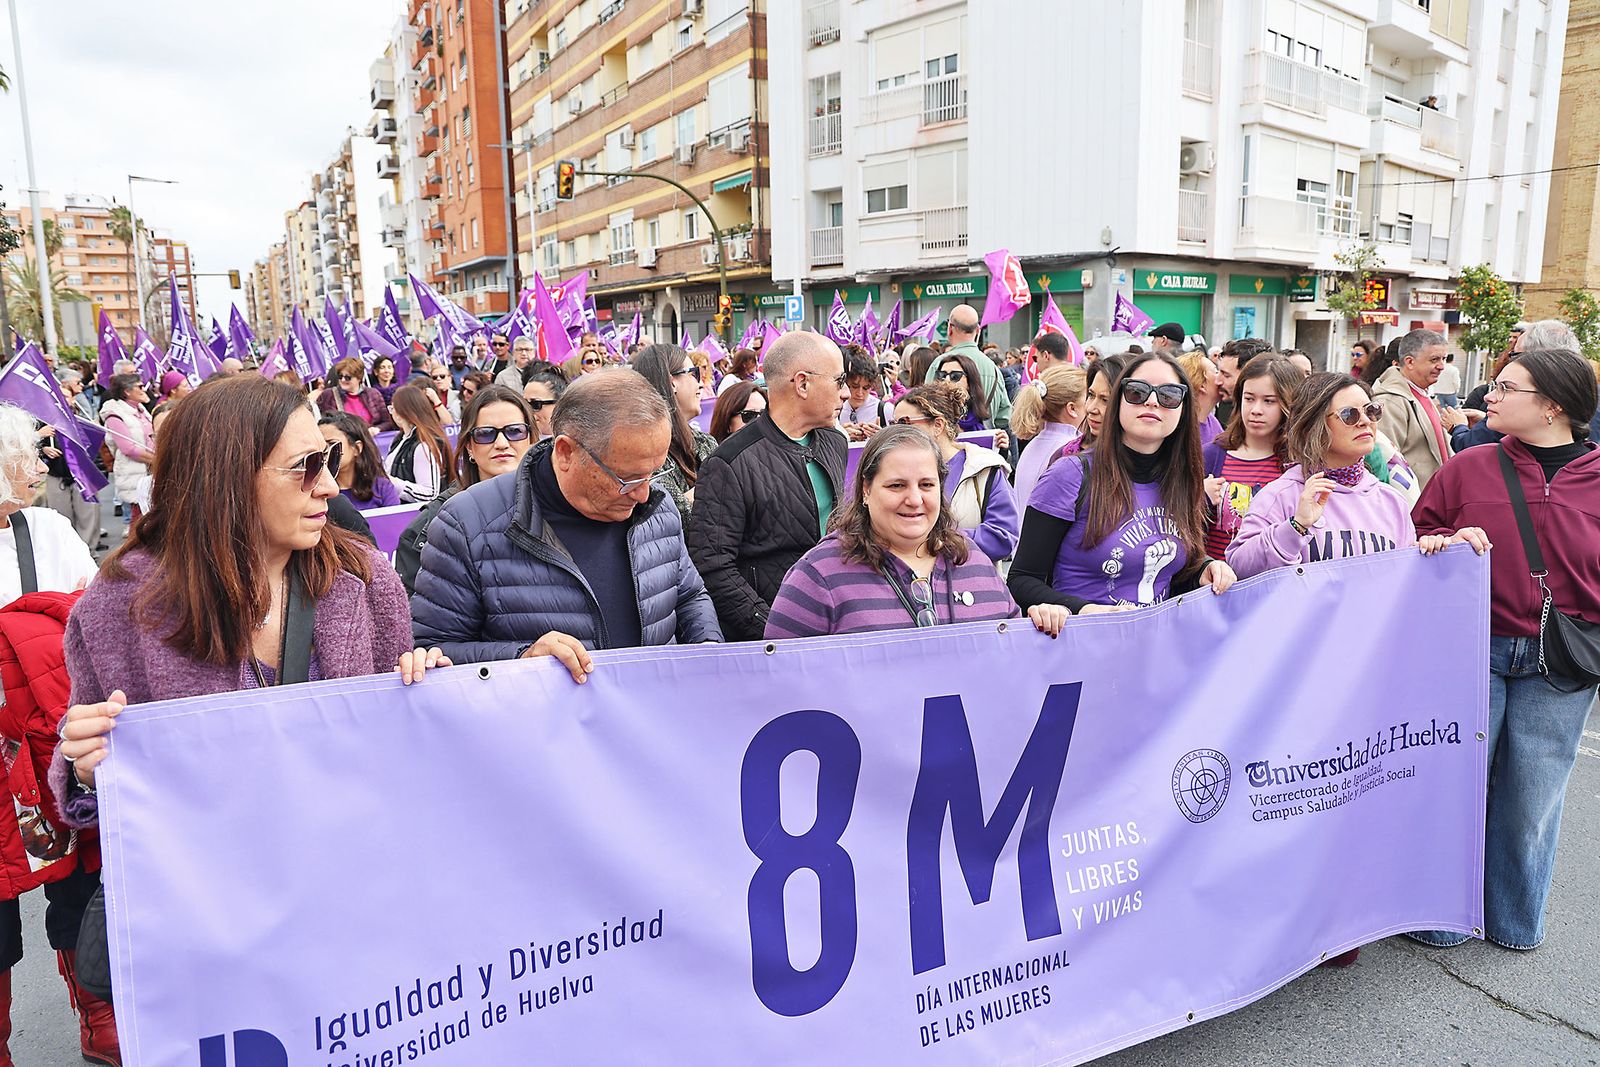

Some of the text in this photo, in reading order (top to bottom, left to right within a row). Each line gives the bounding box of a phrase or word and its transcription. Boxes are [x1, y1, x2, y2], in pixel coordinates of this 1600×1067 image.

[926, 282, 974, 296] CAJA RURAL
[1161, 274, 1208, 289] CAJA RURAL
[788, 299, 799, 319] P
[1119, 517, 1183, 549] VIVAS. LIBR
[1245, 719, 1461, 788] Universidad de Huelva
[1249, 782, 1339, 808] Vicerrectorado
[1341, 777, 1352, 791] de
[1252, 804, 1304, 823] Campus
[1307, 790, 1353, 813] Saludable
[1359, 775, 1385, 799] Justicia
[1386, 765, 1416, 783] Social
[1061, 821, 1148, 858] JUNTAS,
[1066, 858, 1140, 894] LIBRES
[1071, 890, 1144, 930] Y VIVAS
[315, 964, 463, 1054] Igualdad
[478, 962, 496, 999] y
[509, 909, 664, 980] Diversidad
[915, 949, 1070, 1015] DÍA INTERNACIONAL
[326, 1010, 471, 1067] iversidad
[480, 1000, 508, 1028] de
[518, 975, 594, 1017] Huelva
[919, 985, 1052, 1047] DE LAS MUJERES
